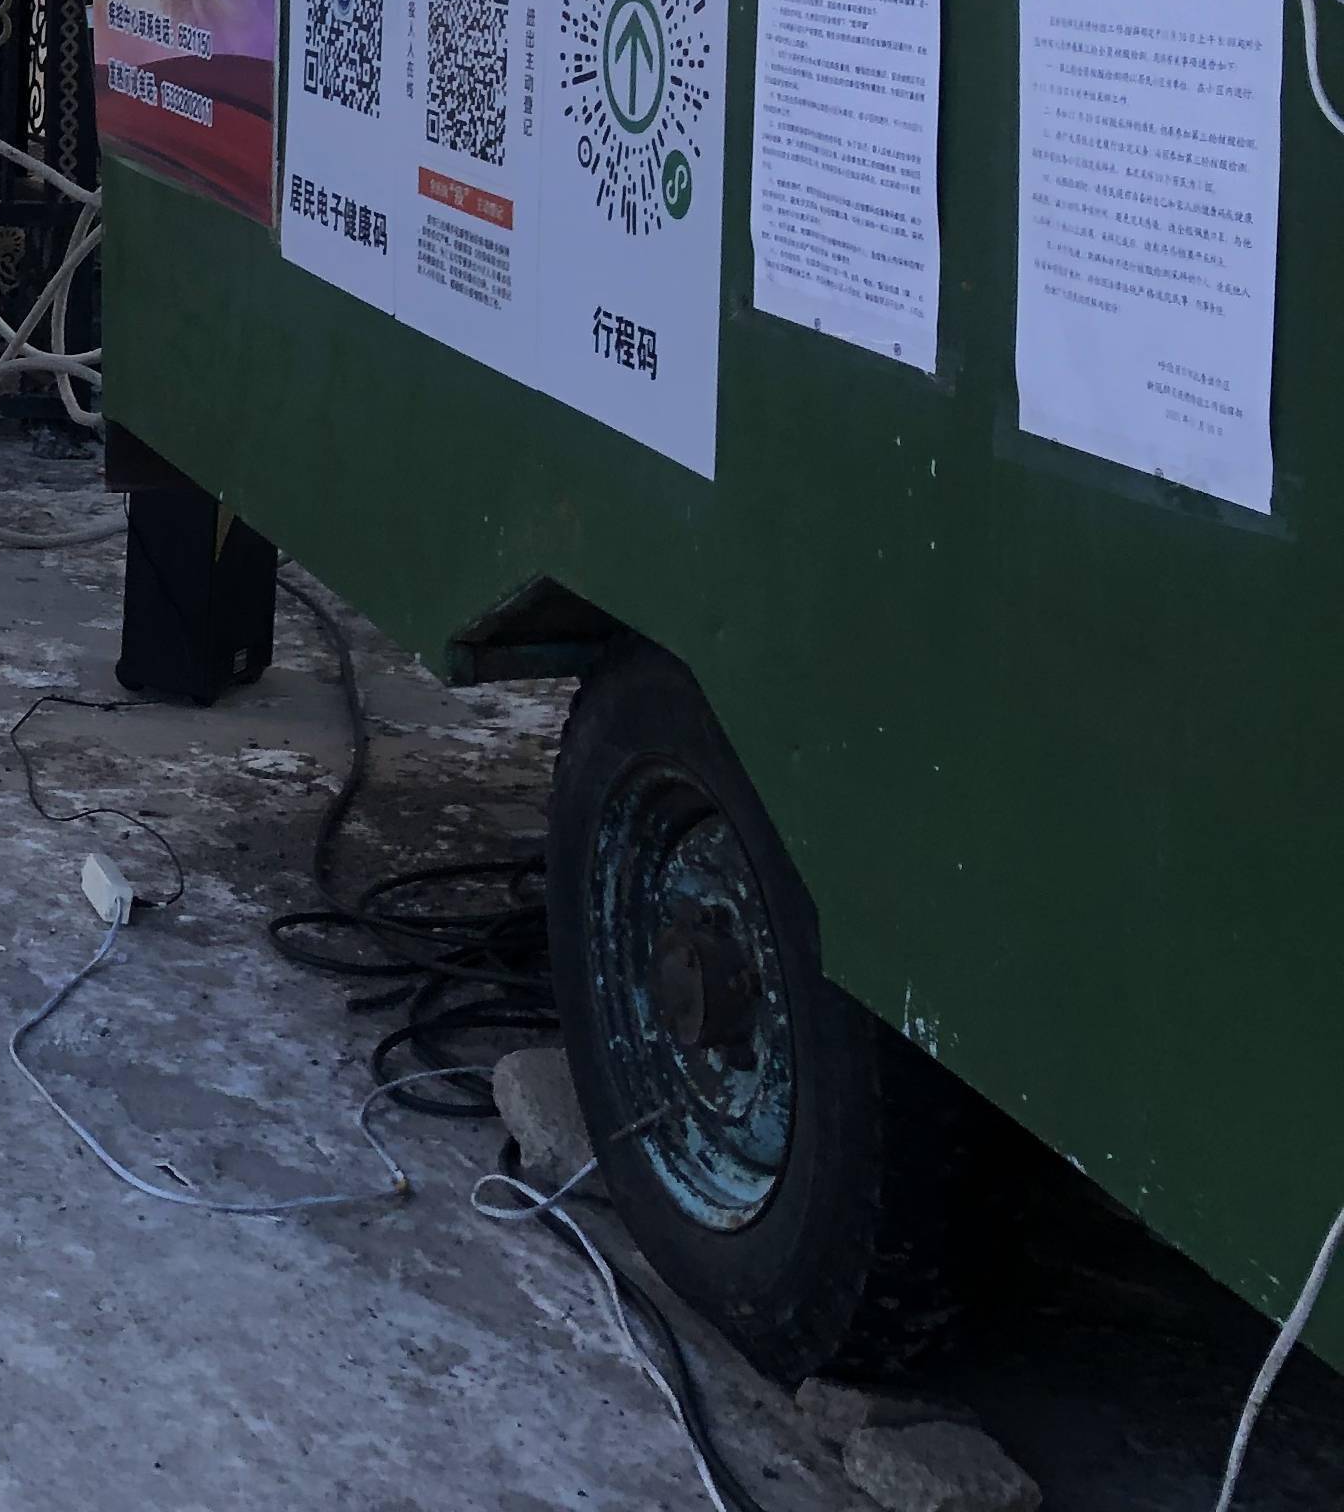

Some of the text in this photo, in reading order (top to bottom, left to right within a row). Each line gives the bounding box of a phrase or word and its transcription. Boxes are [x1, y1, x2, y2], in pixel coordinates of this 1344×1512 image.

[289, 174, 389, 256] 居民电子健康码
[592, 305, 659, 381] 行程码
